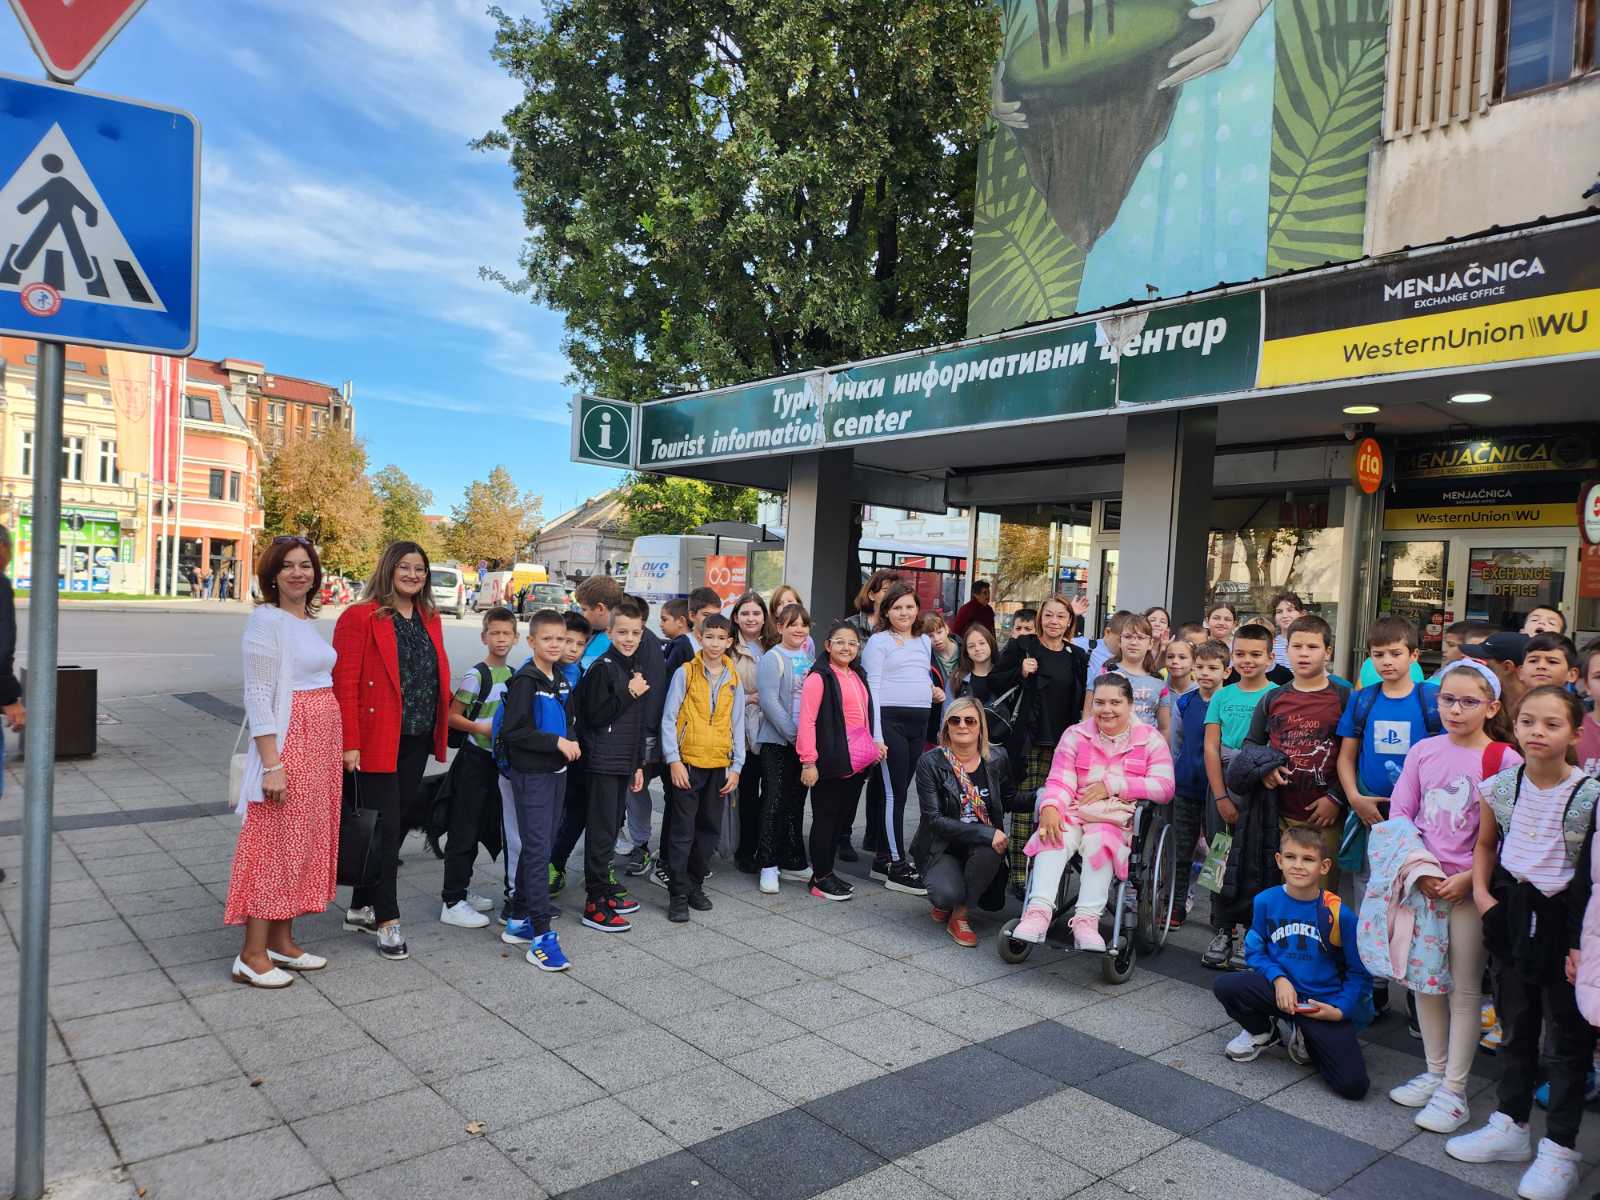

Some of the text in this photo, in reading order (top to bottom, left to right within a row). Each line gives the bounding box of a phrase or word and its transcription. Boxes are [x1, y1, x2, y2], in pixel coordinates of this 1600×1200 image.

[1383, 255, 1546, 303] MENJAČNICA
[1414, 285, 1505, 309] EXCHANGE OFFICE
[1343, 322, 1525, 363] WesternUnion
[893, 340, 1088, 398] информативни
[650, 433, 705, 461] Tourist
[832, 406, 913, 439] center
[1360, 444, 1380, 475] ria
[1442, 487, 1513, 500] MENJAČNICA
[1416, 511, 1510, 524] WesternUnion
[1481, 566, 1552, 597] EXCHANGE OFFICE
